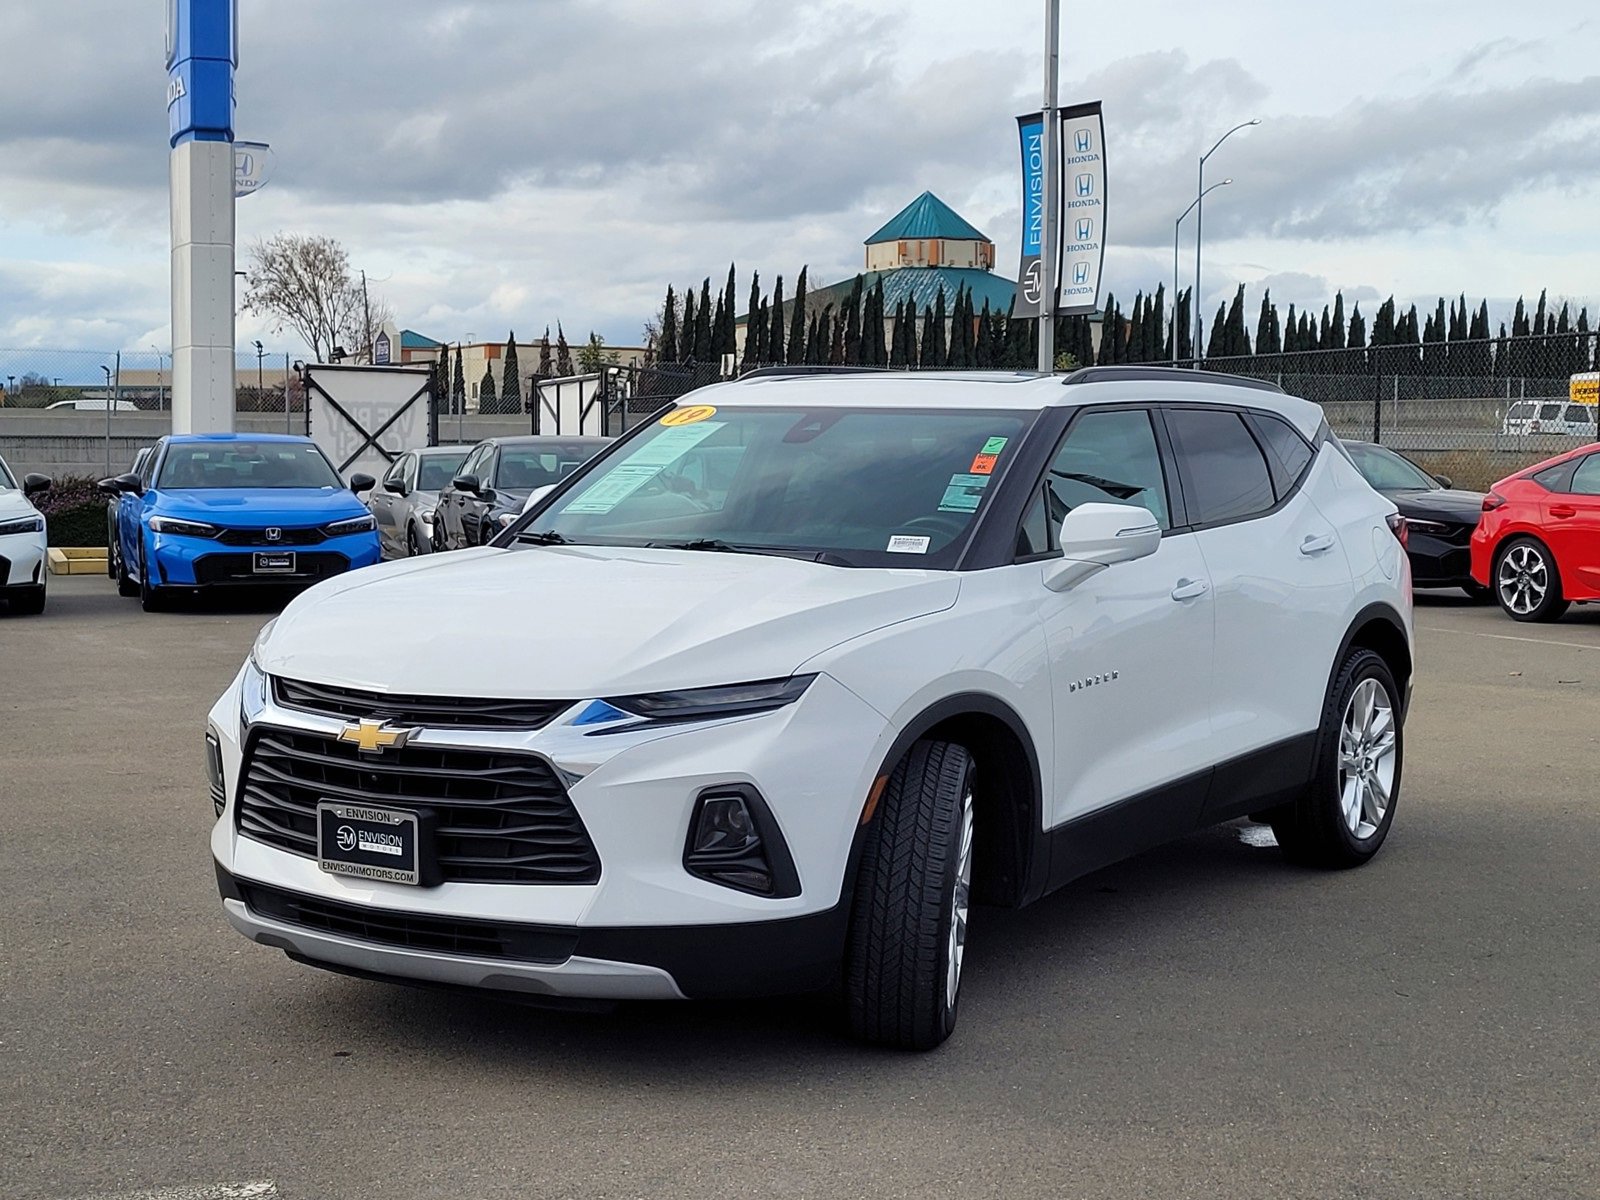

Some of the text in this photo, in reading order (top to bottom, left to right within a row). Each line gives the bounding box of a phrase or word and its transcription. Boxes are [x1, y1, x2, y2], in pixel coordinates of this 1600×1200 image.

[1067, 154, 1100, 164] HONDA
[1028, 134, 1042, 245] ENVISION
[1067, 198, 1101, 208] HONDA
[1066, 243, 1099, 252] HONDA
[1063, 287, 1094, 295] HONDA
[666, 408, 708, 424] 19
[1069, 671, 1119, 692] BLAZER
[346, 808, 391, 823] ENVISION
[358, 830, 402, 847] ENVISION
[362, 844, 399, 854] MOTORS
[322, 861, 414, 882] ENVISIONMOTORS.COM
